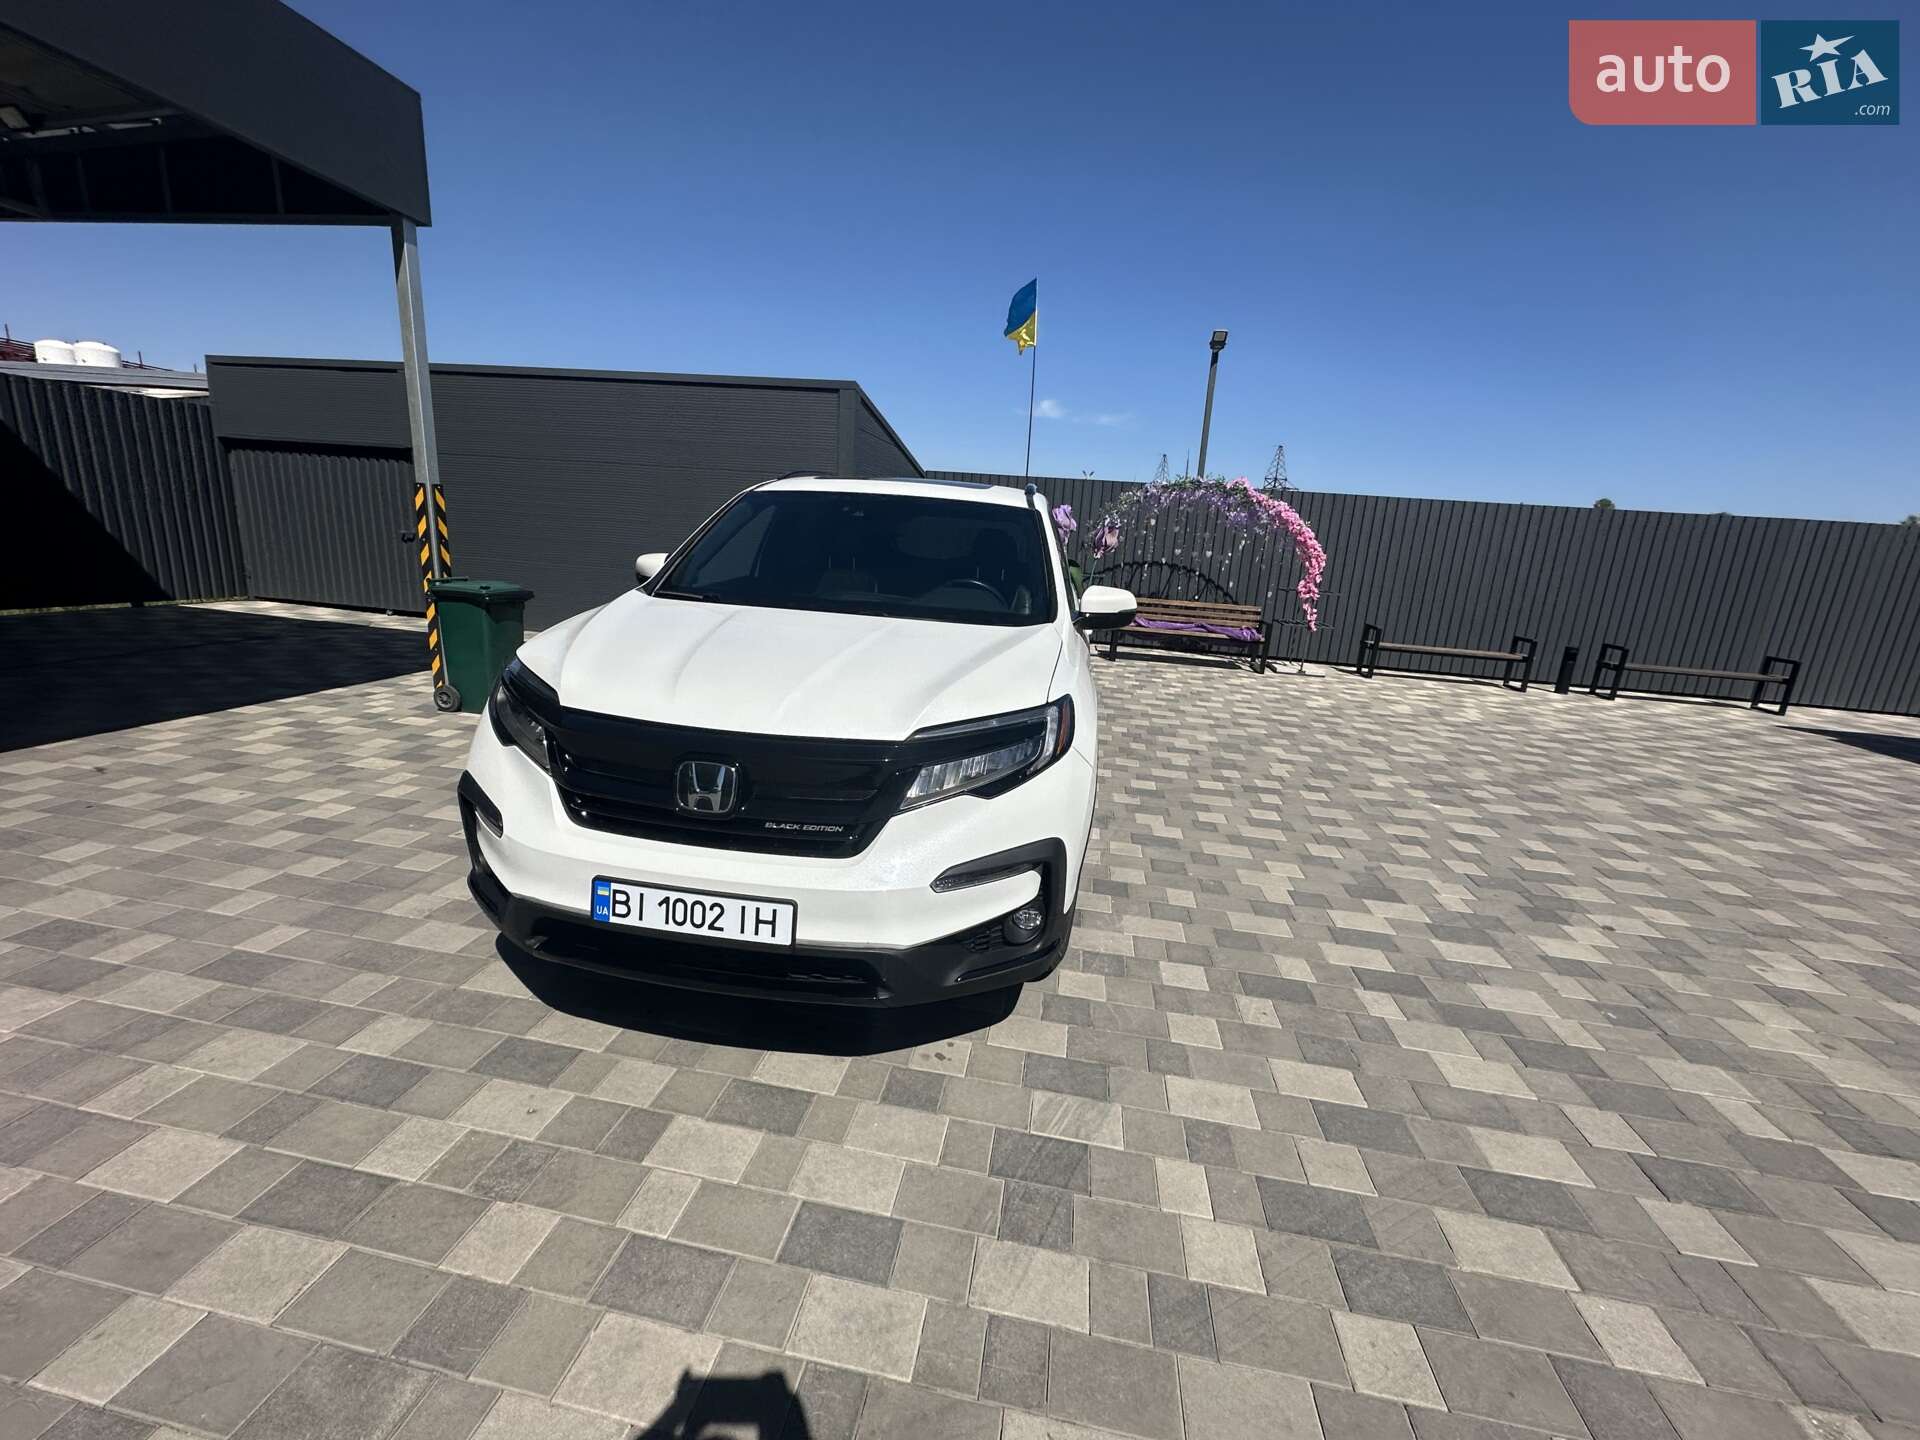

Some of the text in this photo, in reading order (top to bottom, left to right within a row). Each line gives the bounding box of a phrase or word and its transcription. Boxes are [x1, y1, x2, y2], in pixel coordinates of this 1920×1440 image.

[764, 821, 844, 833] BLACK EDITION
[596, 904, 609, 916] UA
[611, 889, 778, 938] BI 1002 IH
